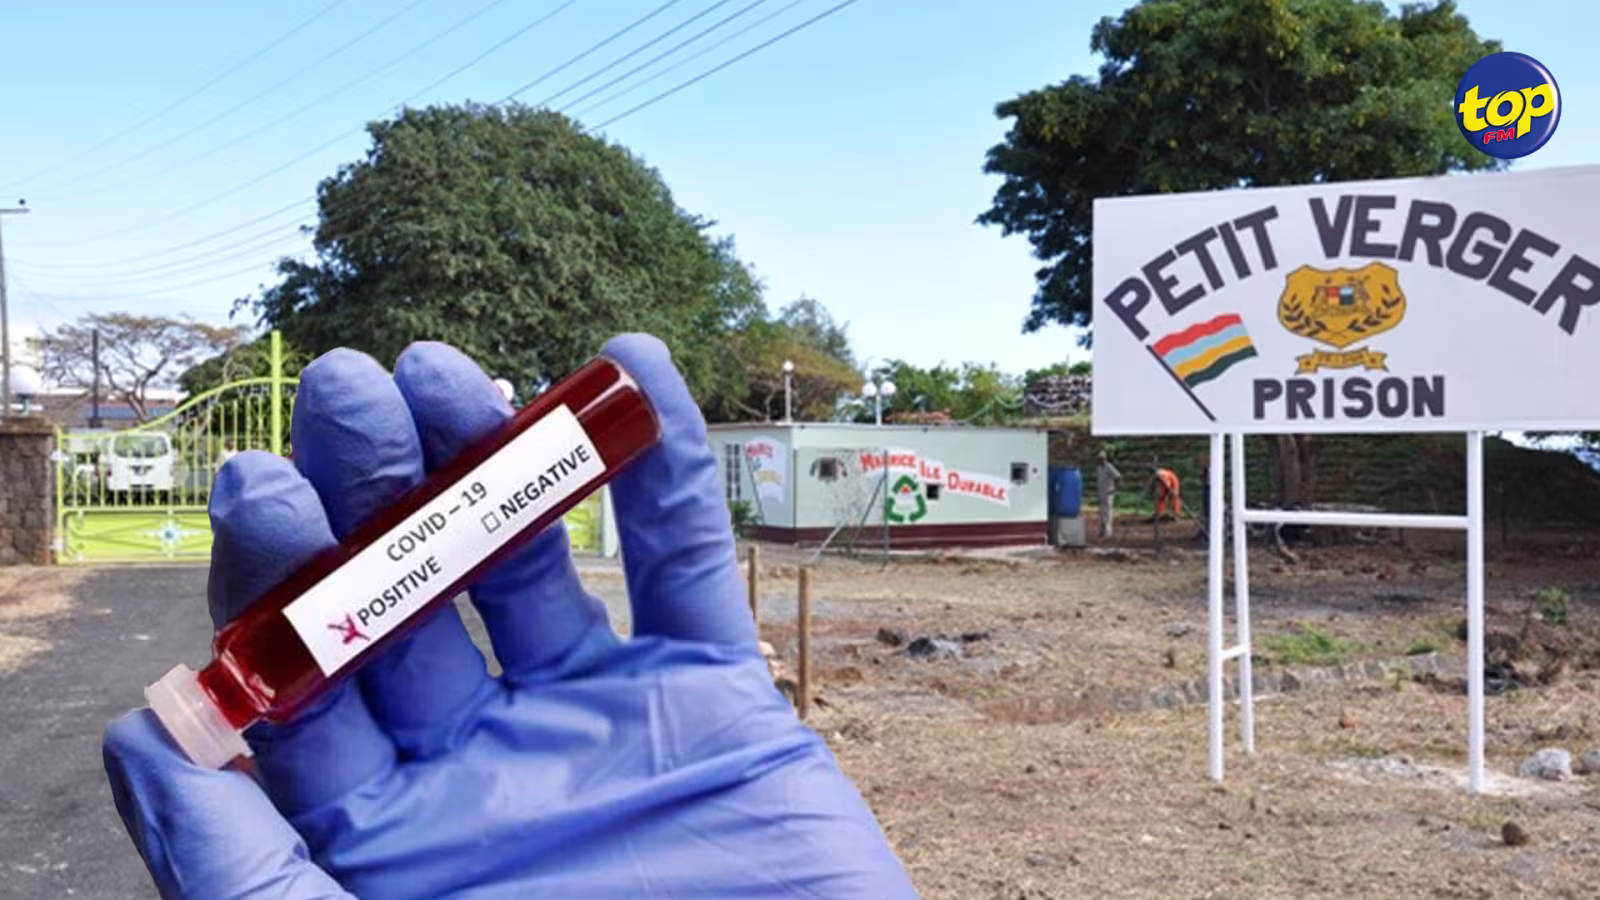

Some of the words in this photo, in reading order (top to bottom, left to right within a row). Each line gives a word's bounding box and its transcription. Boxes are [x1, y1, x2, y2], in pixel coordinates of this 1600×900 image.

[1103, 205, 1279, 342] PETIT
[1308, 194, 1600, 337] VERGER
[1252, 376, 1446, 420] PRISON
[498, 444, 591, 521] NEGATIVE
[386, 510, 448, 563] COVID
[461, 481, 489, 508] 19
[356, 555, 443, 627] POSITIVE
